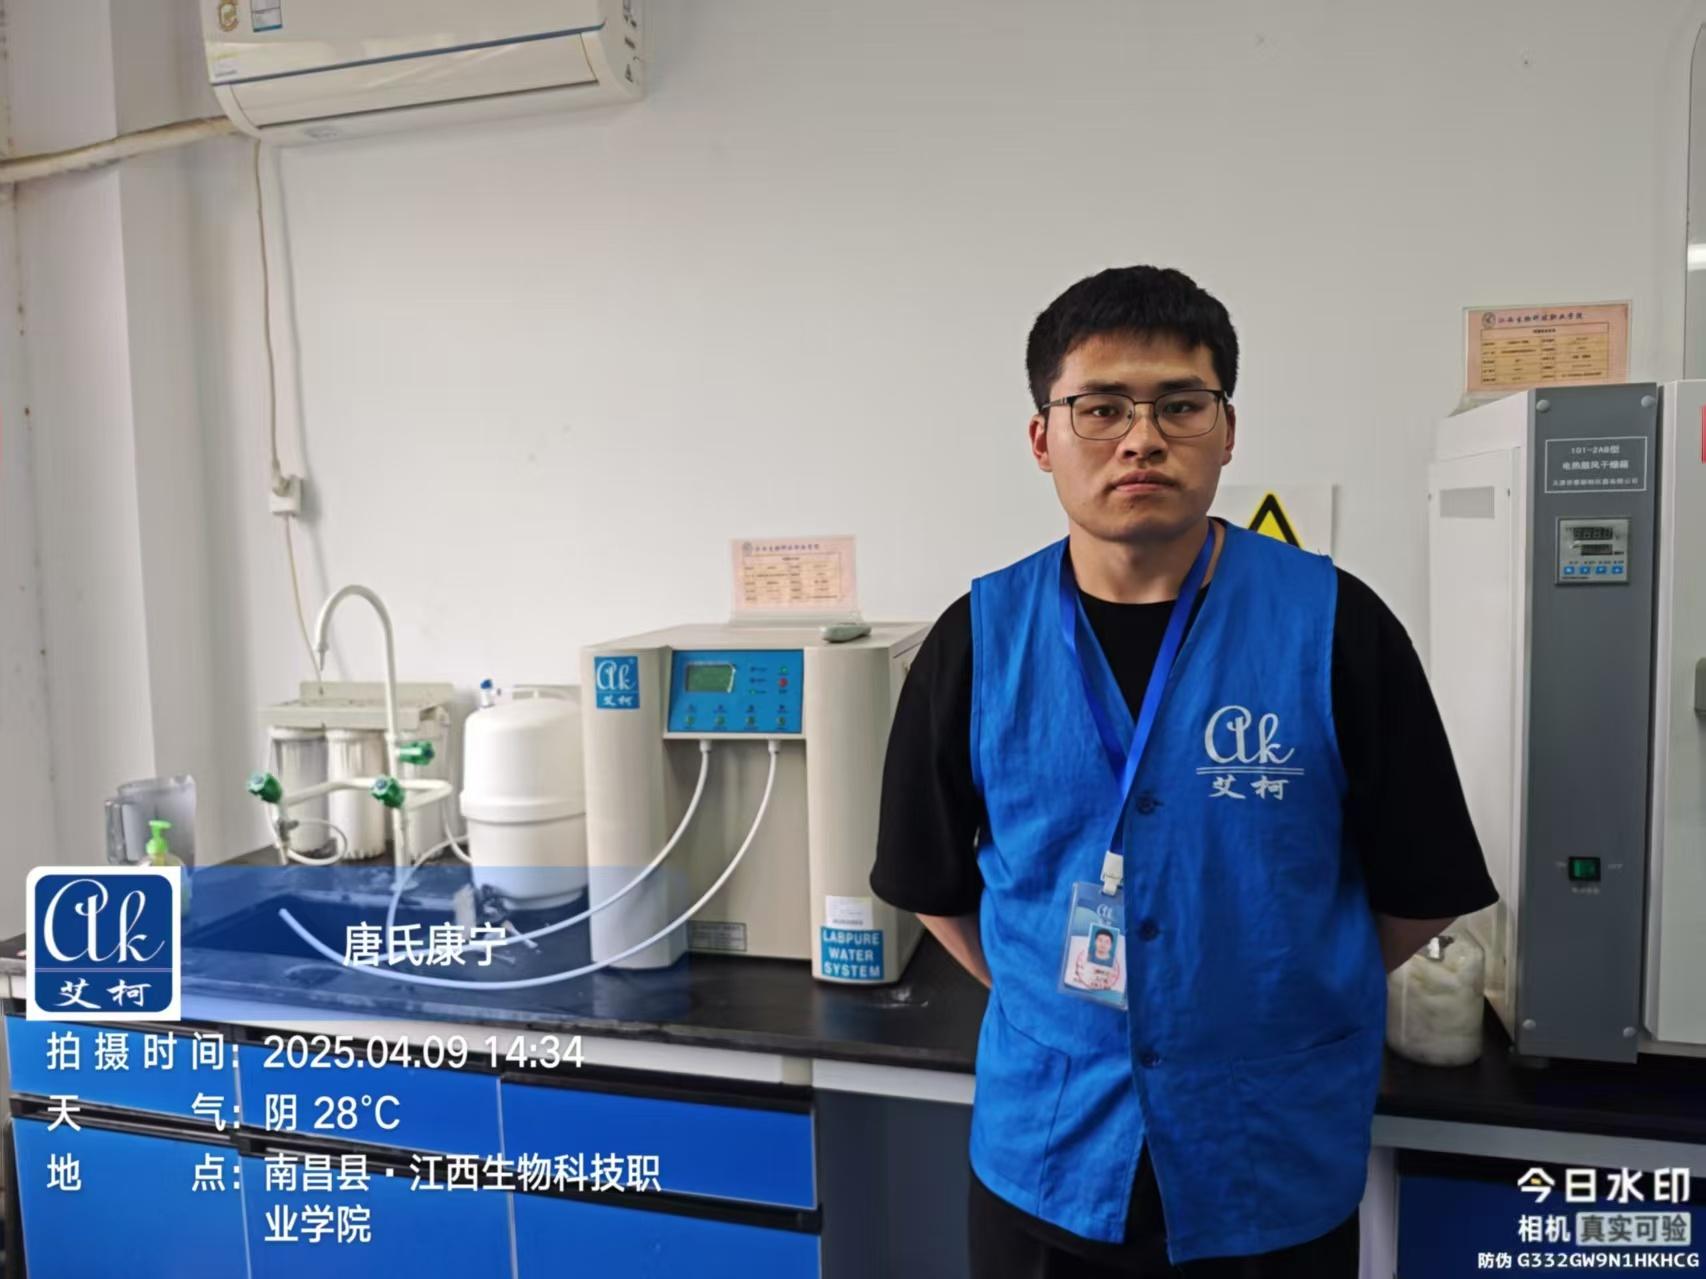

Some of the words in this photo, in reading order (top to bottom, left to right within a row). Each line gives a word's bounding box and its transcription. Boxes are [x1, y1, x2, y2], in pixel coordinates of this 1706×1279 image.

[1208, 773, 1290, 801] 艾柯
[822, 931, 880, 945] LABPURE
[828, 947, 873, 961] WATER
[823, 962, 881, 977] SYSTEM
